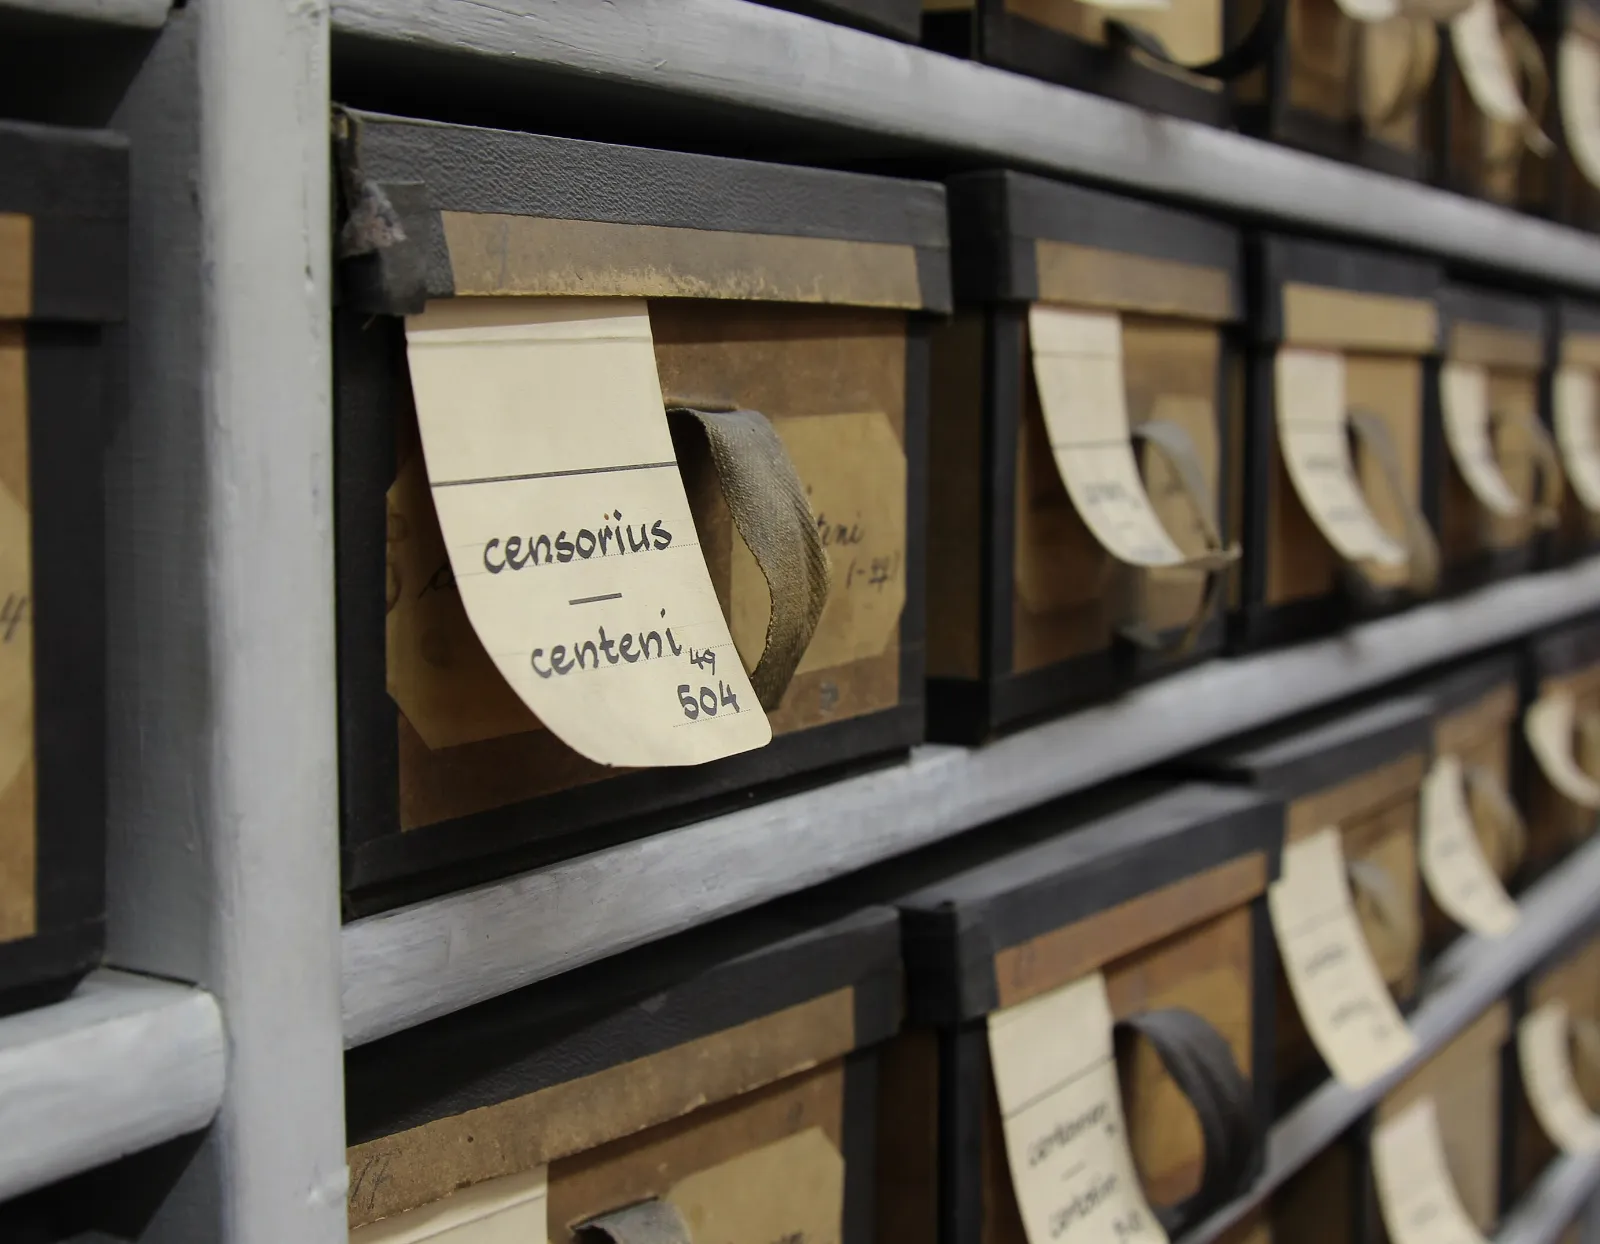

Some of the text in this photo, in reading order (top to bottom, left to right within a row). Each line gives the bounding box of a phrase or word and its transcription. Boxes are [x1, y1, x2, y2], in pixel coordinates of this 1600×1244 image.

[483, 508, 673, 575] censorius
[530, 607, 683, 679] centeni
[689, 646, 716, 676] 49
[676, 679, 740, 720] 504
